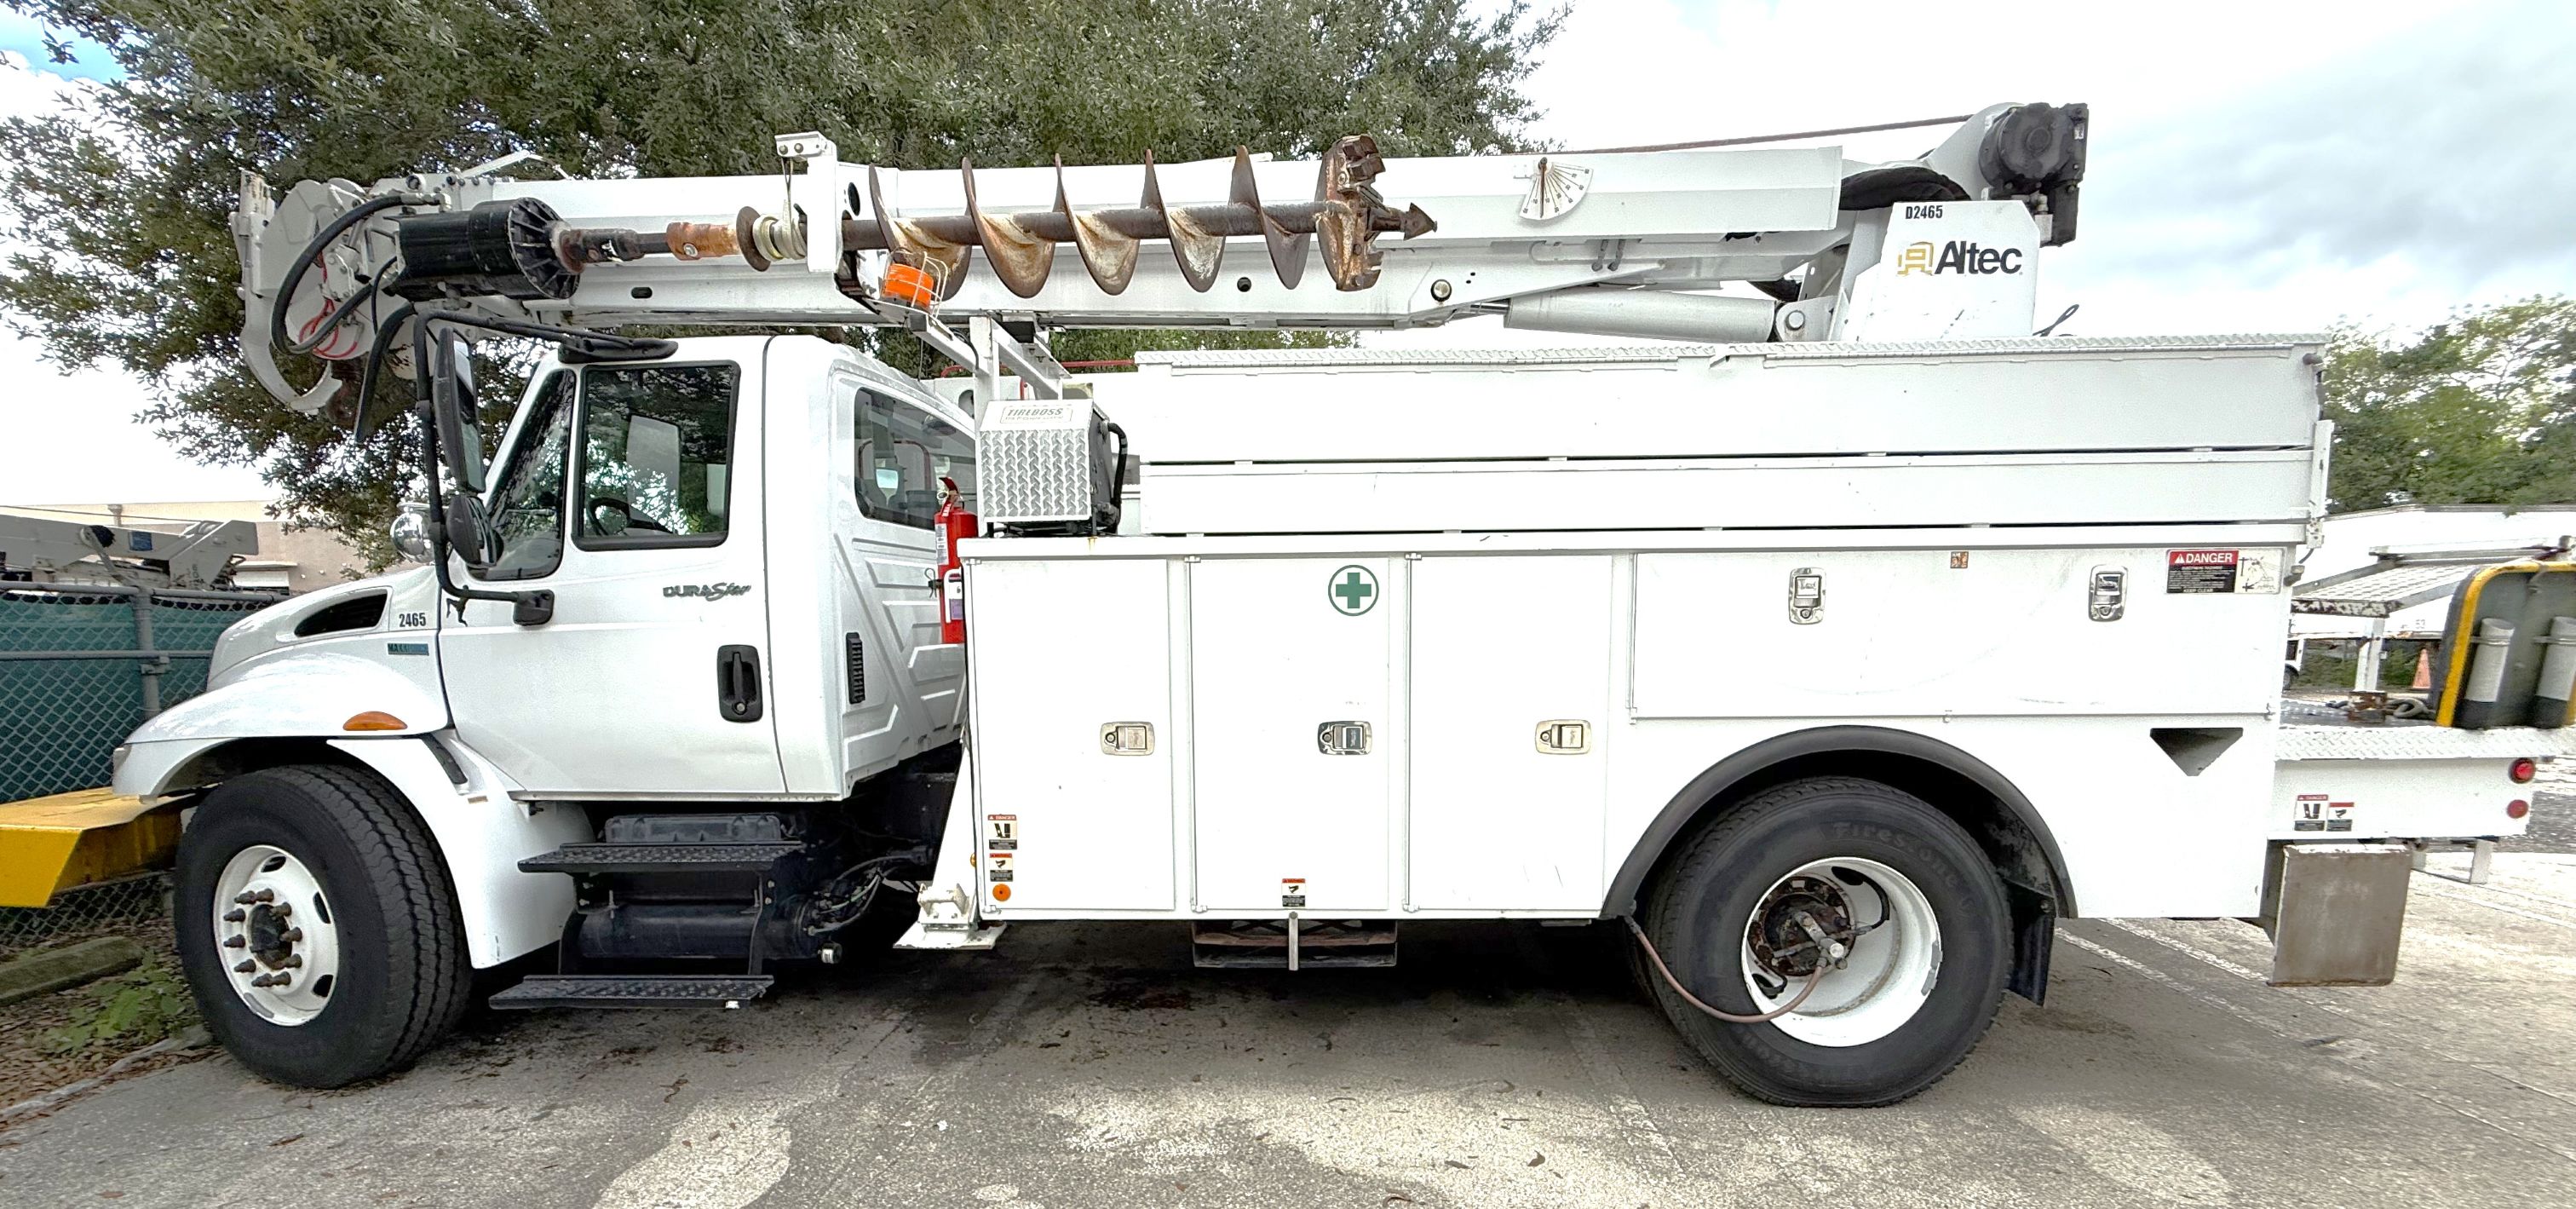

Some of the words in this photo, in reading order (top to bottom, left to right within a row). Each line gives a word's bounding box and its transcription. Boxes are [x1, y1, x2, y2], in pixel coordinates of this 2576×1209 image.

[1905, 205, 1943, 220] D2465
[1934, 240, 2022, 275] Altec
[1007, 408, 1064, 417] TIREBOSS
[2185, 553, 2233, 563] DANGER
[399, 612, 427, 628] 2465
